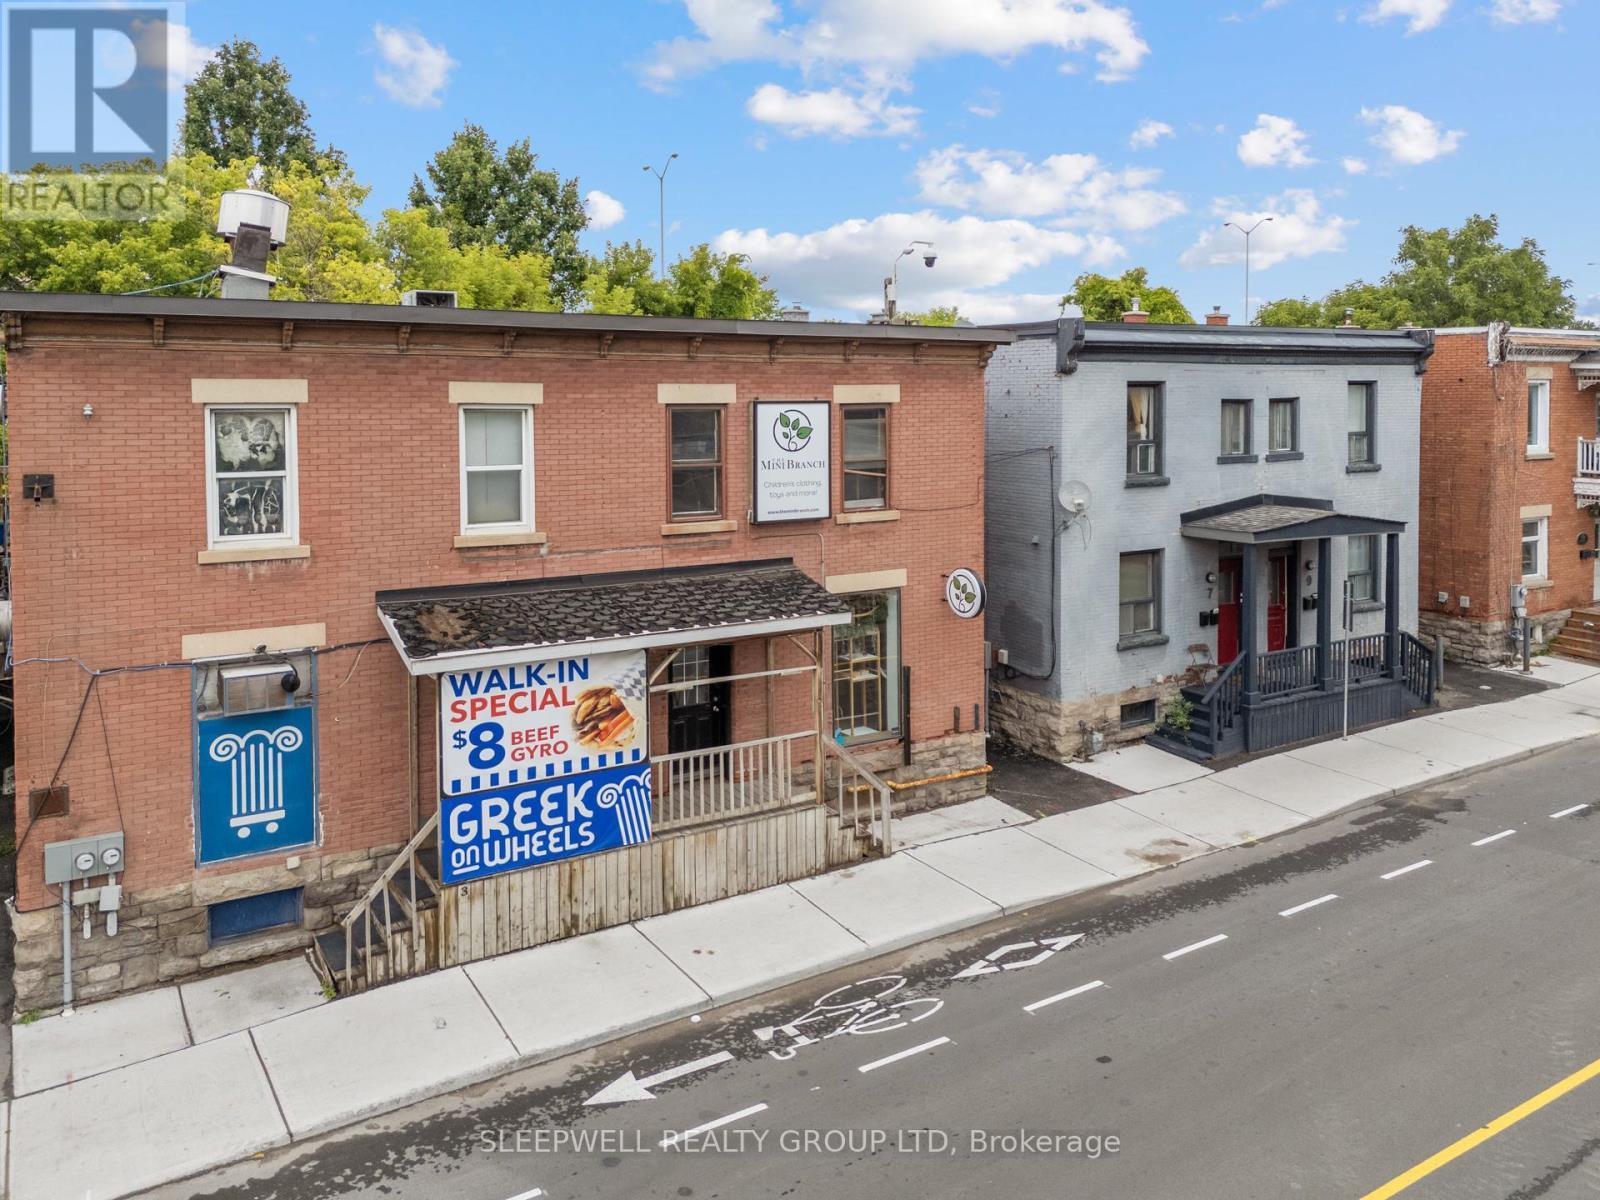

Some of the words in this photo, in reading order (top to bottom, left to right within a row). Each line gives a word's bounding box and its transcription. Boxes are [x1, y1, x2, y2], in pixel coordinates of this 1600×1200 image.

[1207, 587, 1213, 599] 7
[449, 658, 589, 697] WALK-IN
[450, 686, 576, 723] SPECIAL
[511, 725, 560, 745] BEEF
[511, 740, 569, 762] GYRO
[449, 780, 594, 845] GREEK
[484, 821, 595, 867] WHEELS
